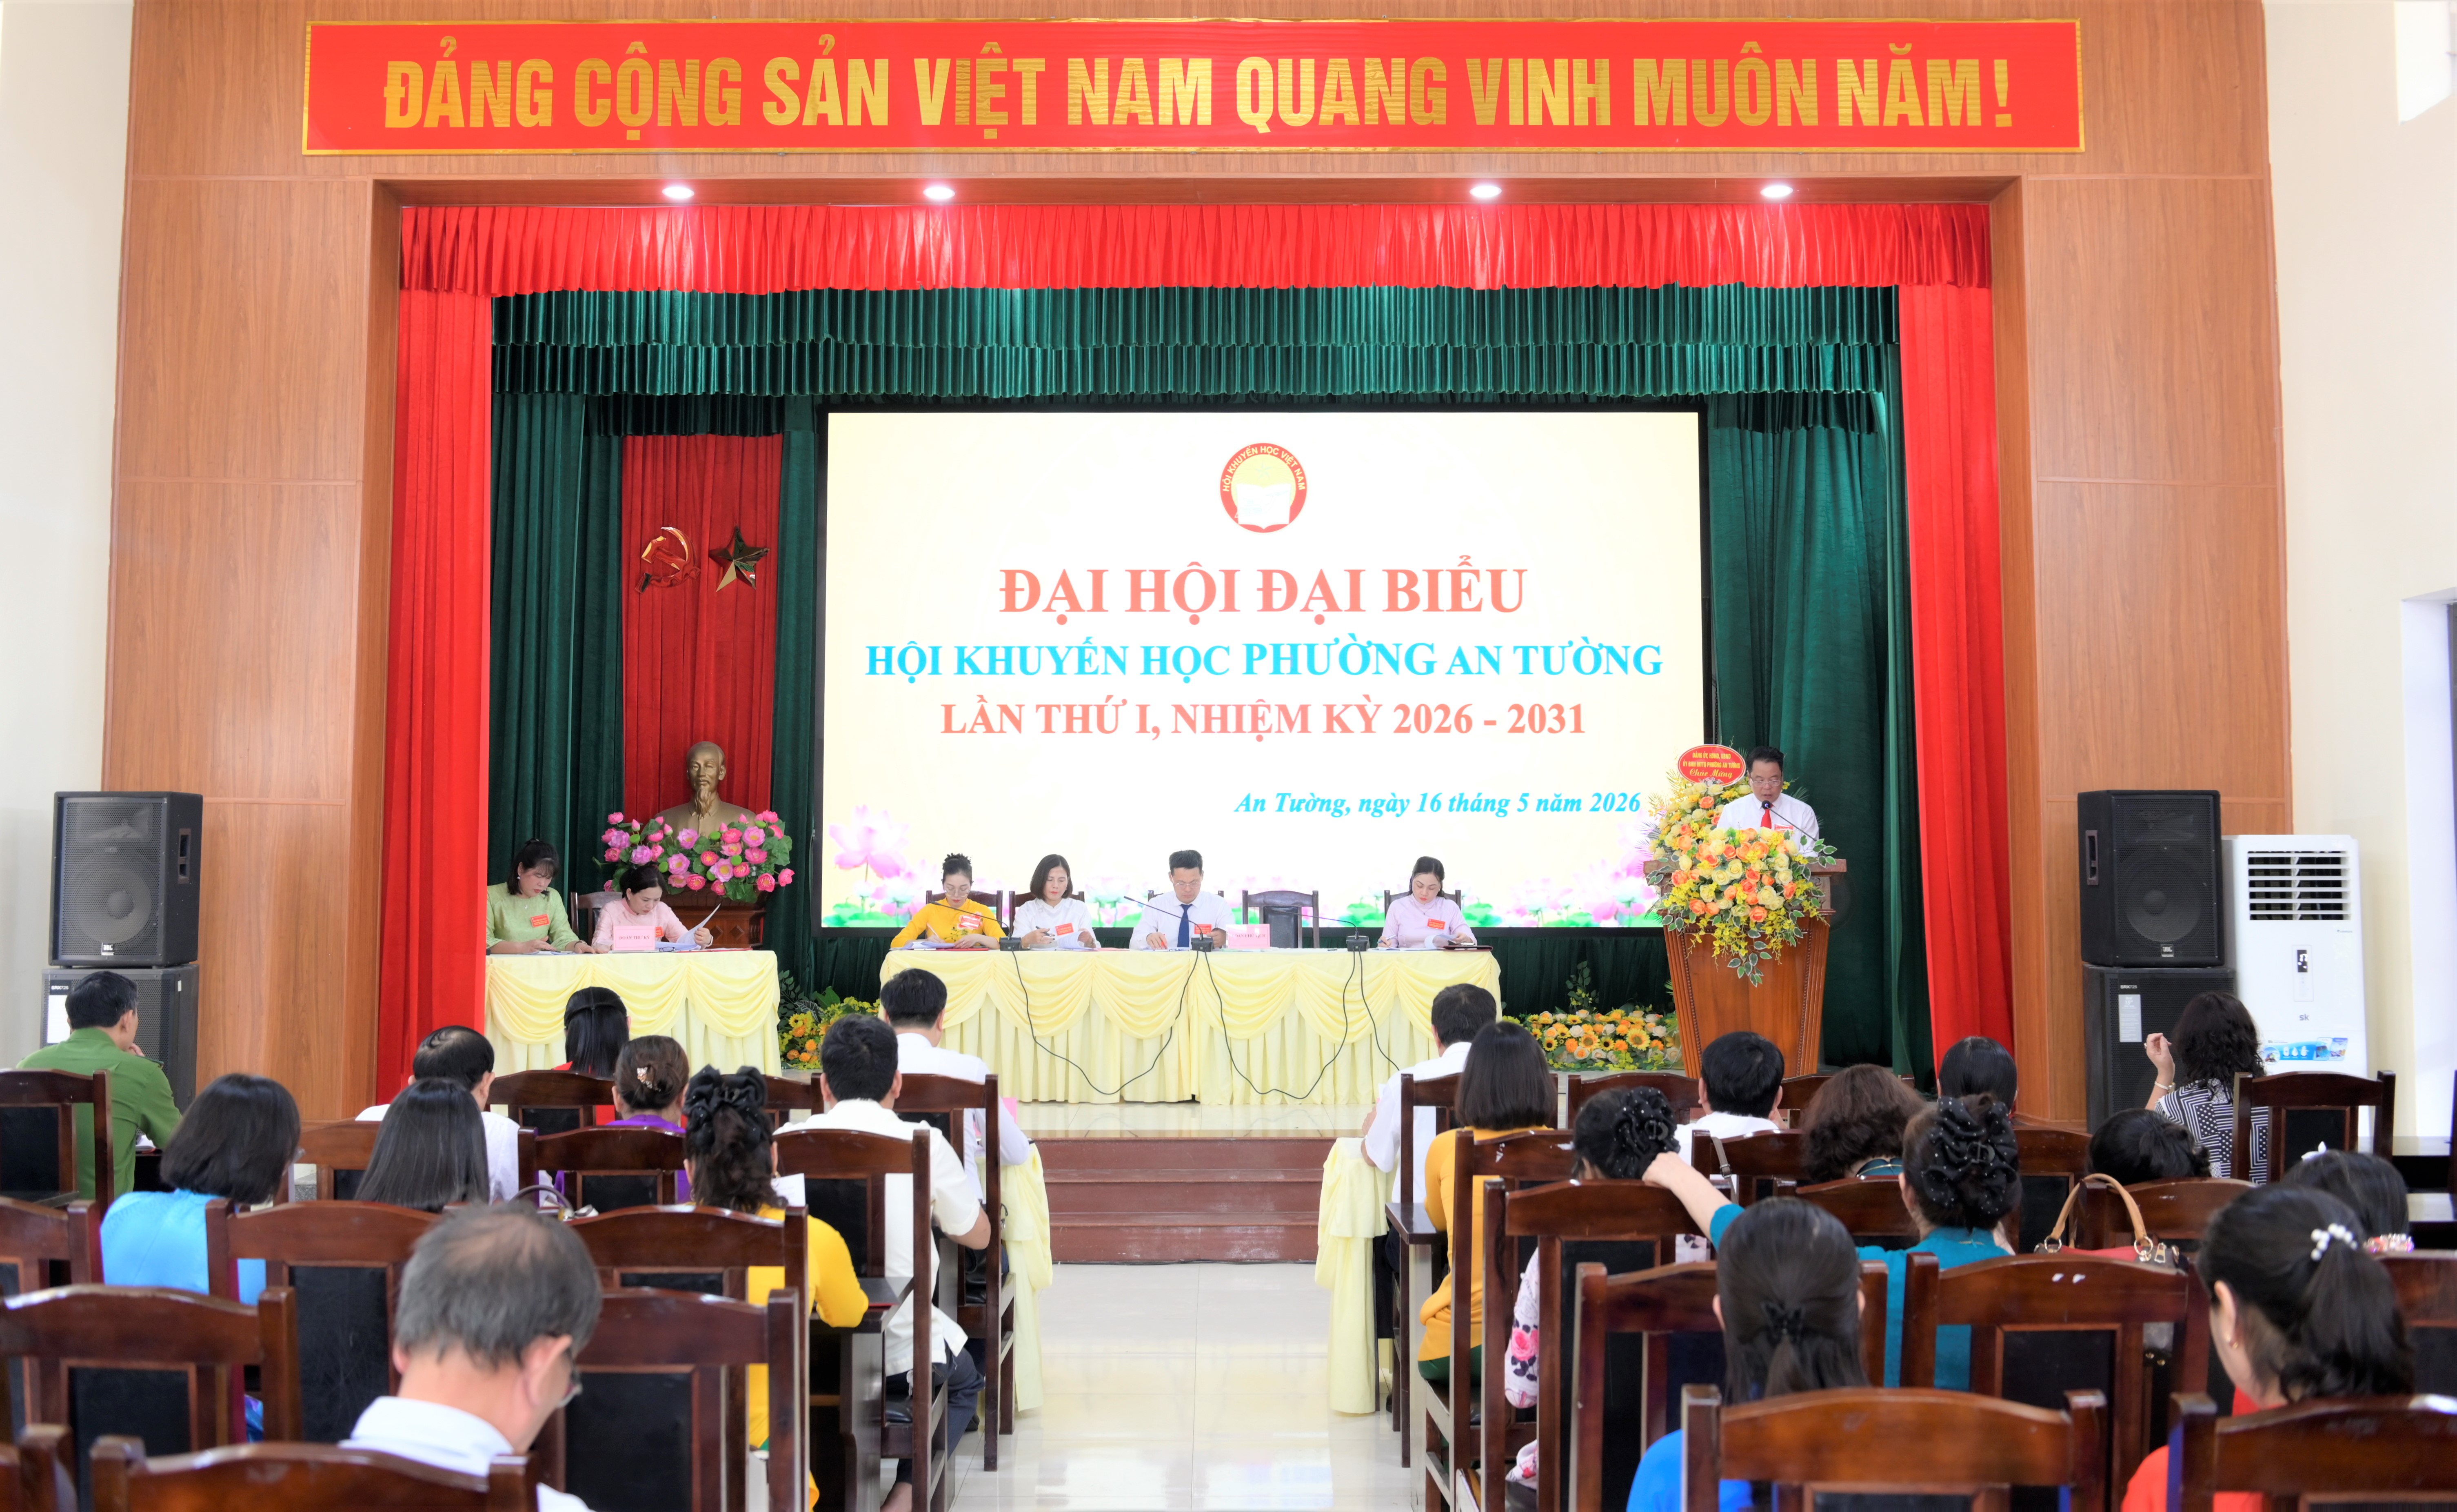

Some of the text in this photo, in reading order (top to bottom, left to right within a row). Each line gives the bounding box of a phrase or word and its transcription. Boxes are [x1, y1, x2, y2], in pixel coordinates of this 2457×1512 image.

[384, 36, 553, 128] ĐẢNG
[575, 42, 741, 140] CỘNG
[763, 34, 888, 126] SẢN
[914, 42, 1045, 139] VIỆT
[1068, 58, 1212, 125] NAM
[1236, 57, 1446, 133] QUANG
[1466, 58, 1610, 125] VINH
[1634, 42, 1818, 127] MUÔN
[1222, 446, 1305, 491] HỘI KHUYẾN HỌC VIỆT NAM
[1000, 555, 1527, 625] ĐẠI HỘI ĐẠI BIỂU
[866, 633, 1662, 684] HỘI KHUYẾN HỌC PHƯỜNG AN TƯỜNG
[941, 695, 1025, 733] LẦN
[1036, 695, 1127, 734] THỨ
[1136, 705, 1160, 740] I,
[1172, 699, 1311, 742] NHIỆM
[1323, 695, 1382, 733] KỲ
[1394, 704, 1472, 733] 2026
[1508, 704, 1585, 733] 2031
[1689, 768, 1733, 779] Chúc Mừng
[1234, 793, 1640, 817] An Tường, ngày 16 tháng 5 năm 2026
